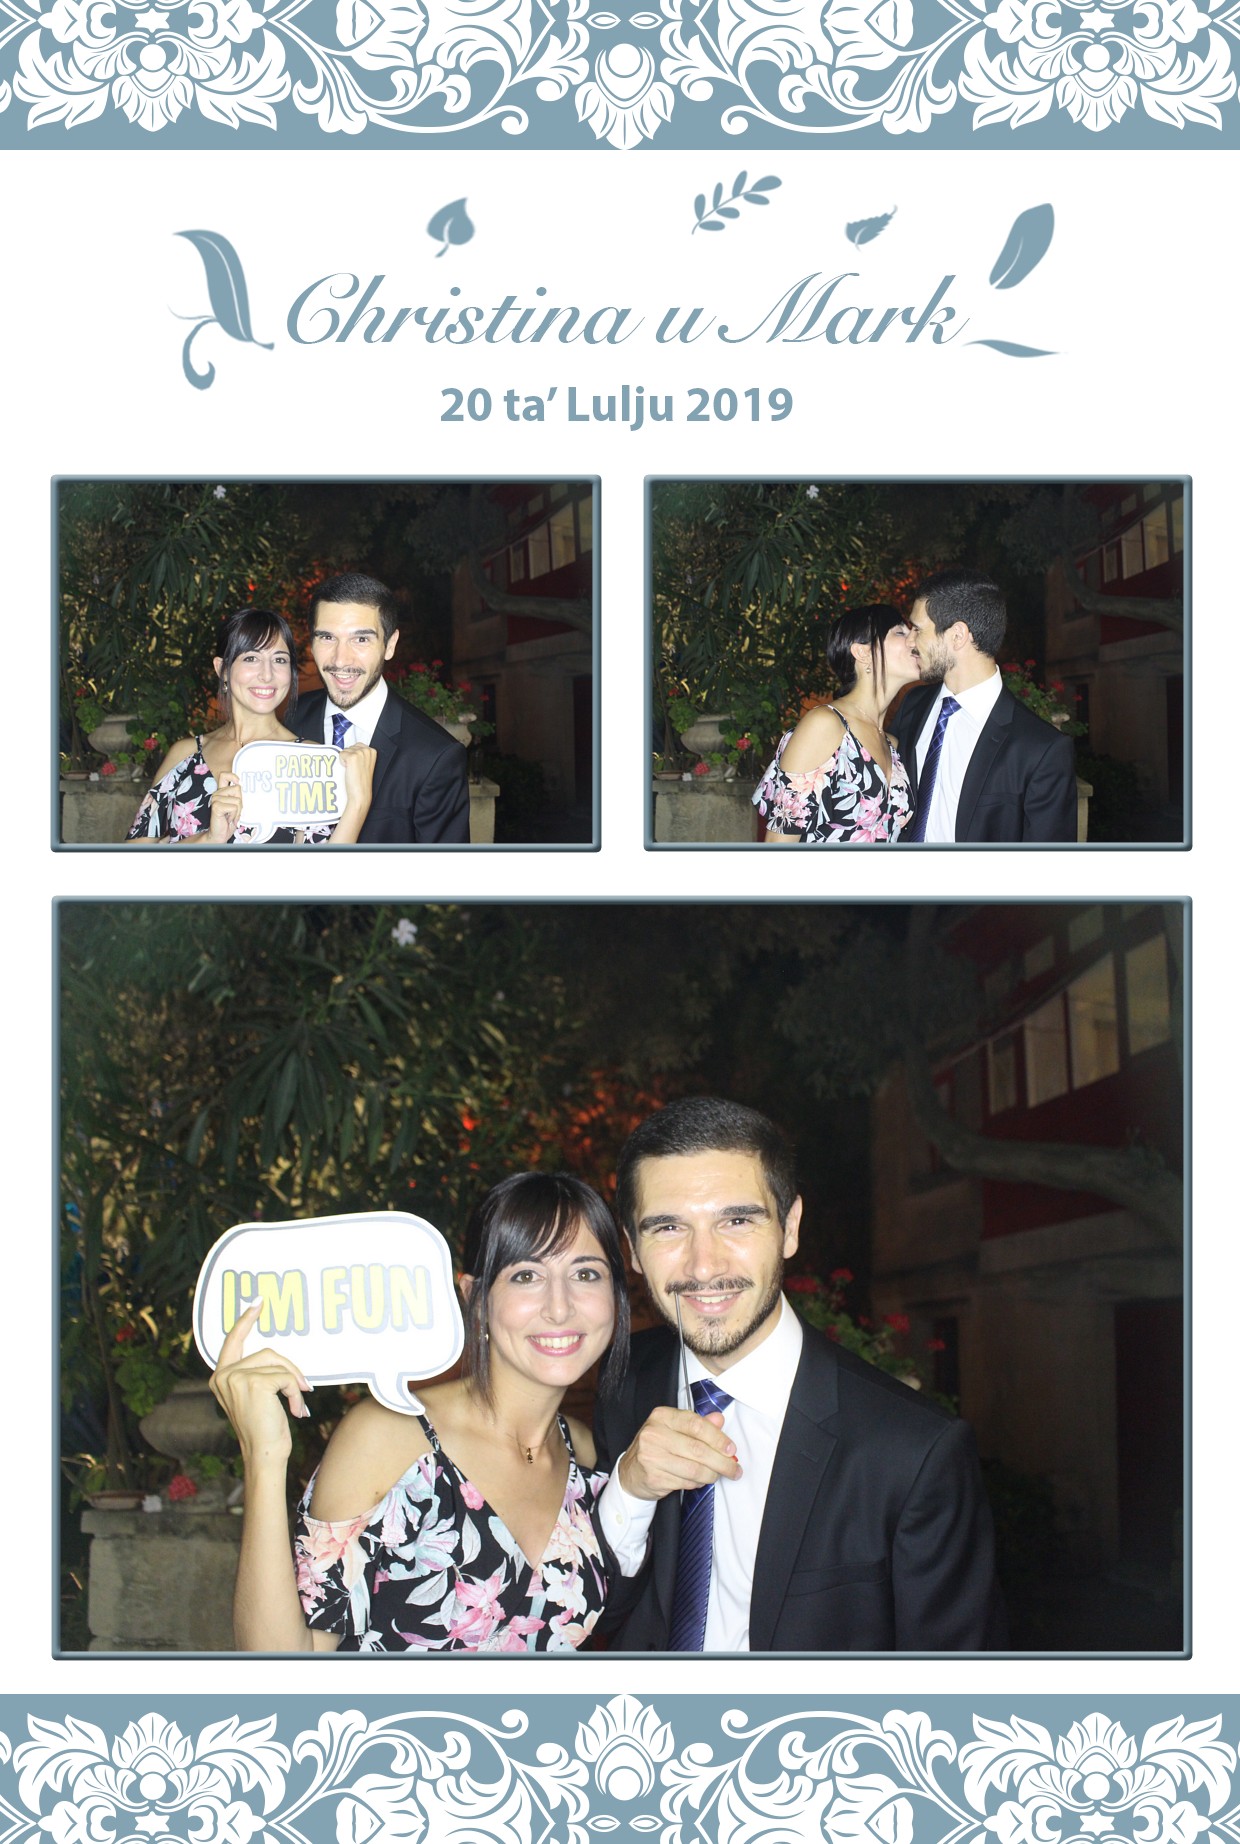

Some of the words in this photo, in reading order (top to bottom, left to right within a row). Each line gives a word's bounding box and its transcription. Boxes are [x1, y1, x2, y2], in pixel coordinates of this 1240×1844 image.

[275, 754, 337, 778] PARTY
[241, 771, 272, 793] IT'S
[275, 781, 338, 814] TIME
[222, 1269, 309, 1337] I'M
[321, 1263, 434, 1335] FUN
